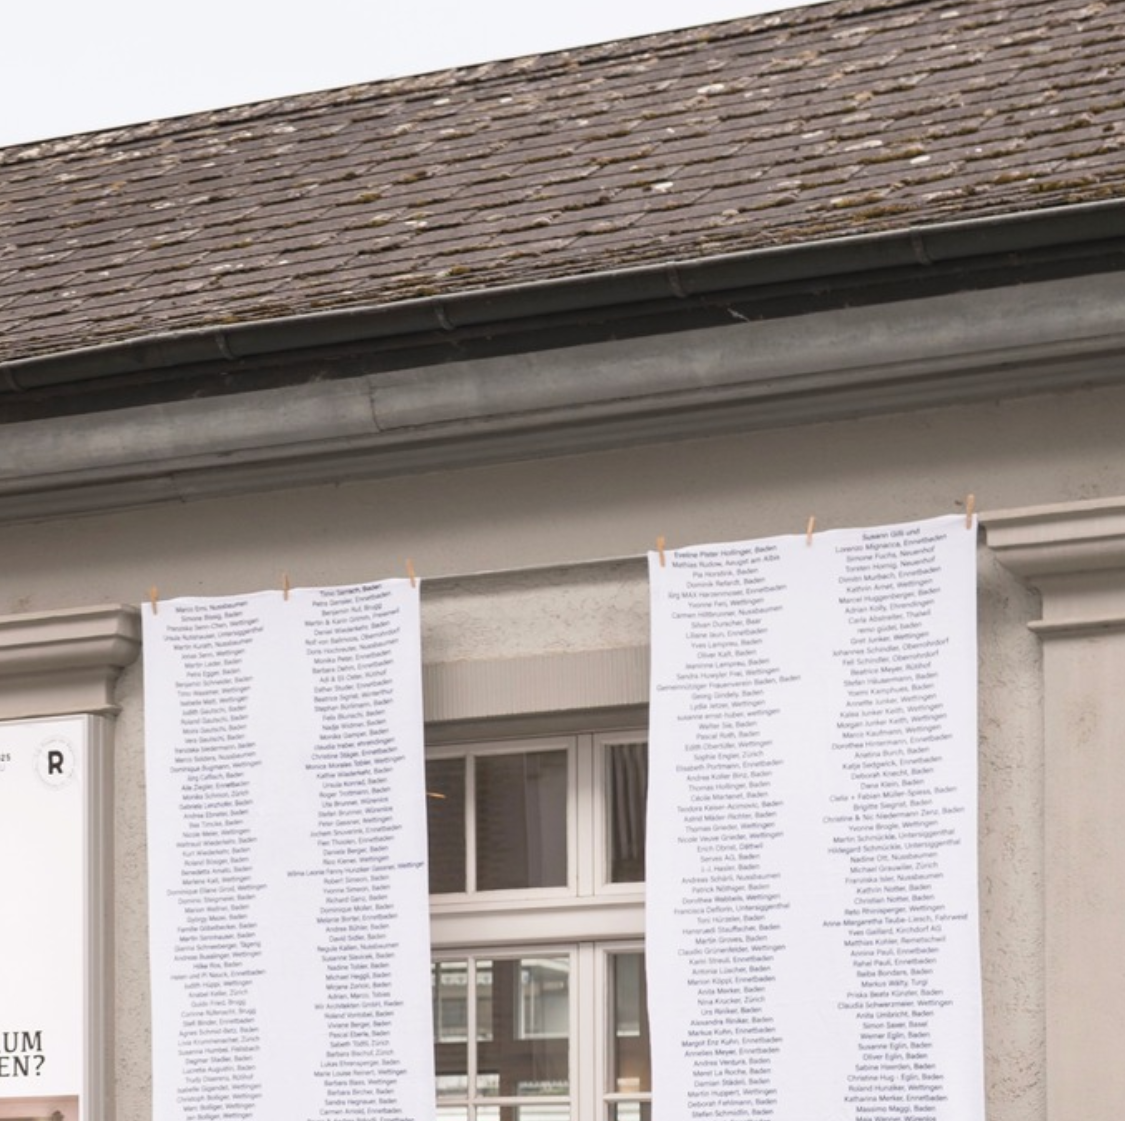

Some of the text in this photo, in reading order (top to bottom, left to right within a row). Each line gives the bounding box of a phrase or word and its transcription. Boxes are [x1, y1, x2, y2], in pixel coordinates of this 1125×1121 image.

[903, 534, 946, 546] Ennetbaden
[900, 546, 934, 557] Neuenhof
[918, 587, 940, 596] Baden
[371, 621, 390, 629] Baden
[900, 693, 936, 702] Wettingen
[910, 734, 952, 744] Ennetbaden
[361, 747, 397, 756] Ennetbaden
[48, 750, 64, 775] R
[905, 1052, 927, 1060] Baden
[908, 1084, 942, 1092] Wettingen
[906, 1094, 947, 1102] Ennetbaden
